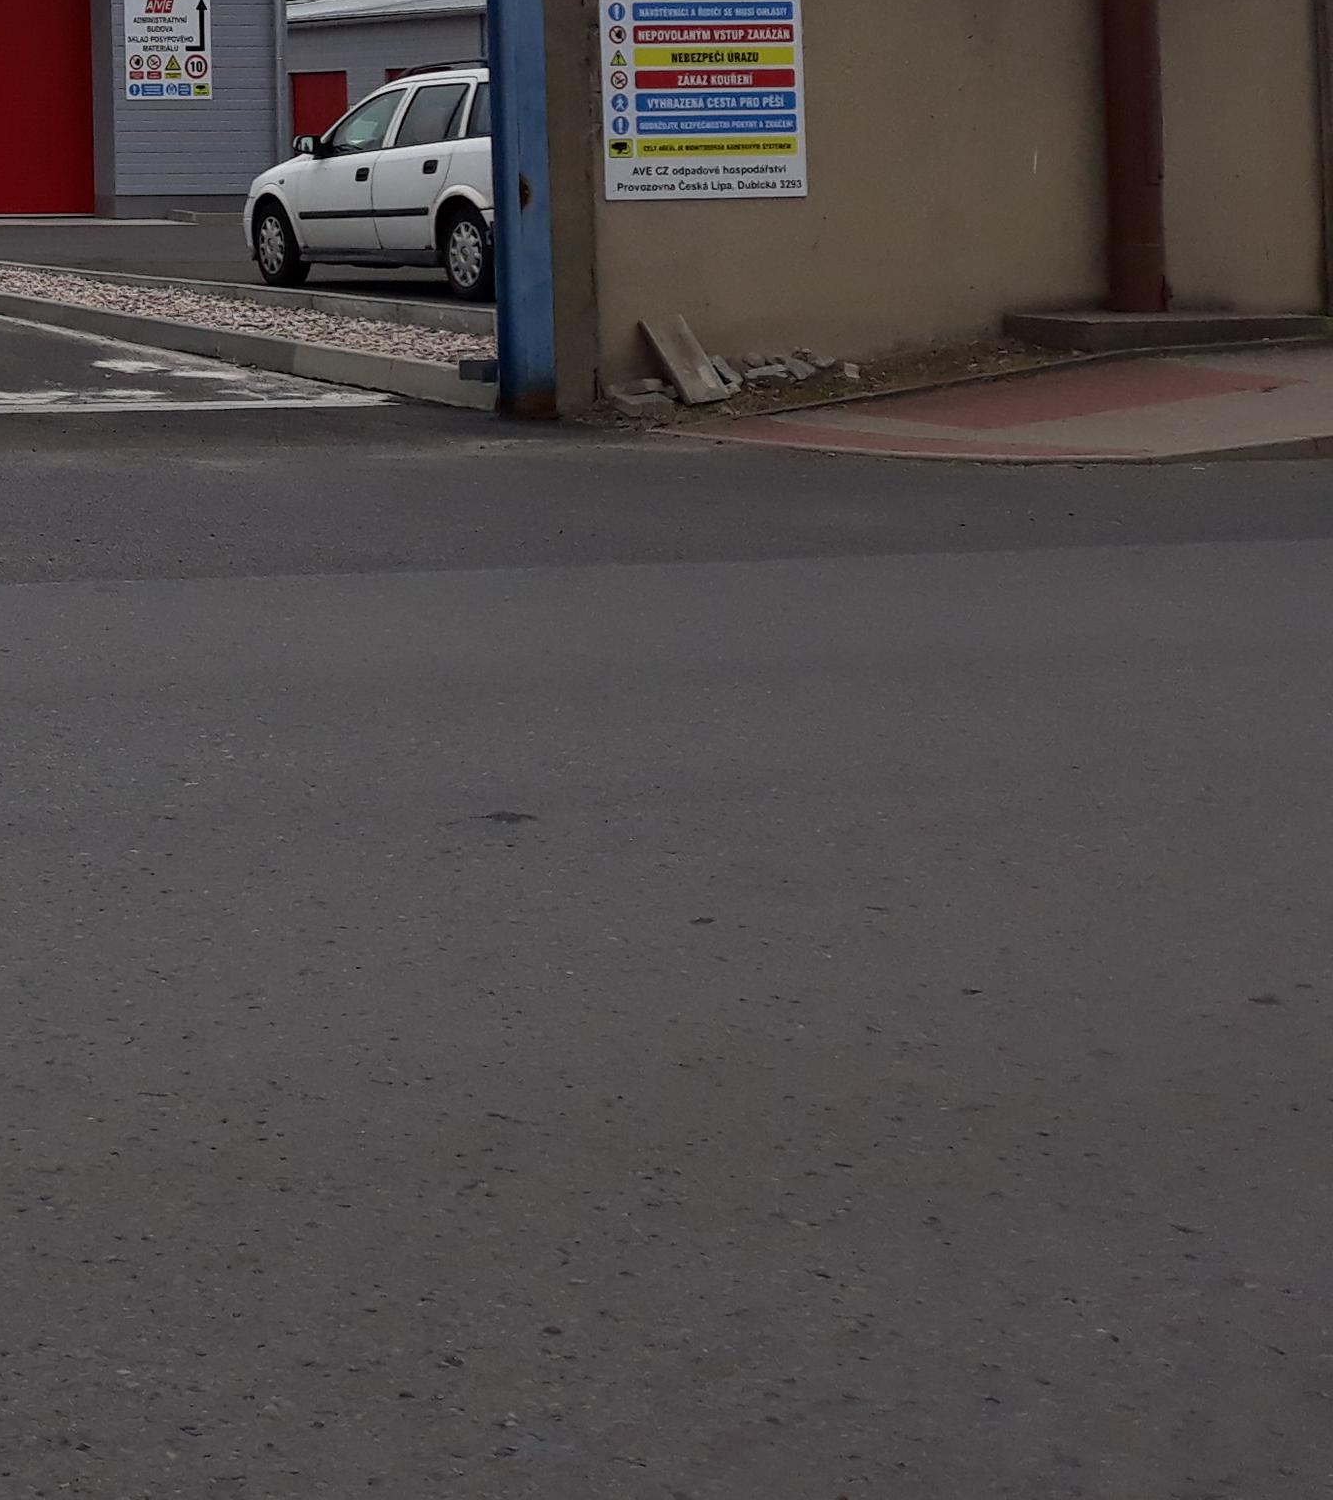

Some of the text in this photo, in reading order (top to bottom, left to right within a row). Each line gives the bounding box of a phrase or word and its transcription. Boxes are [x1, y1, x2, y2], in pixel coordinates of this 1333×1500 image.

[146, 0, 173, 11] AVE
[713, 29, 745, 41] VSTUP
[190, 60, 203, 73] 10
[631, 166, 653, 176] AVE
[655, 165, 670, 176] CZ
[616, 182, 676, 192] Provozovna
[678, 180, 709, 191] Česká
[779, 179, 802, 189] 3293
